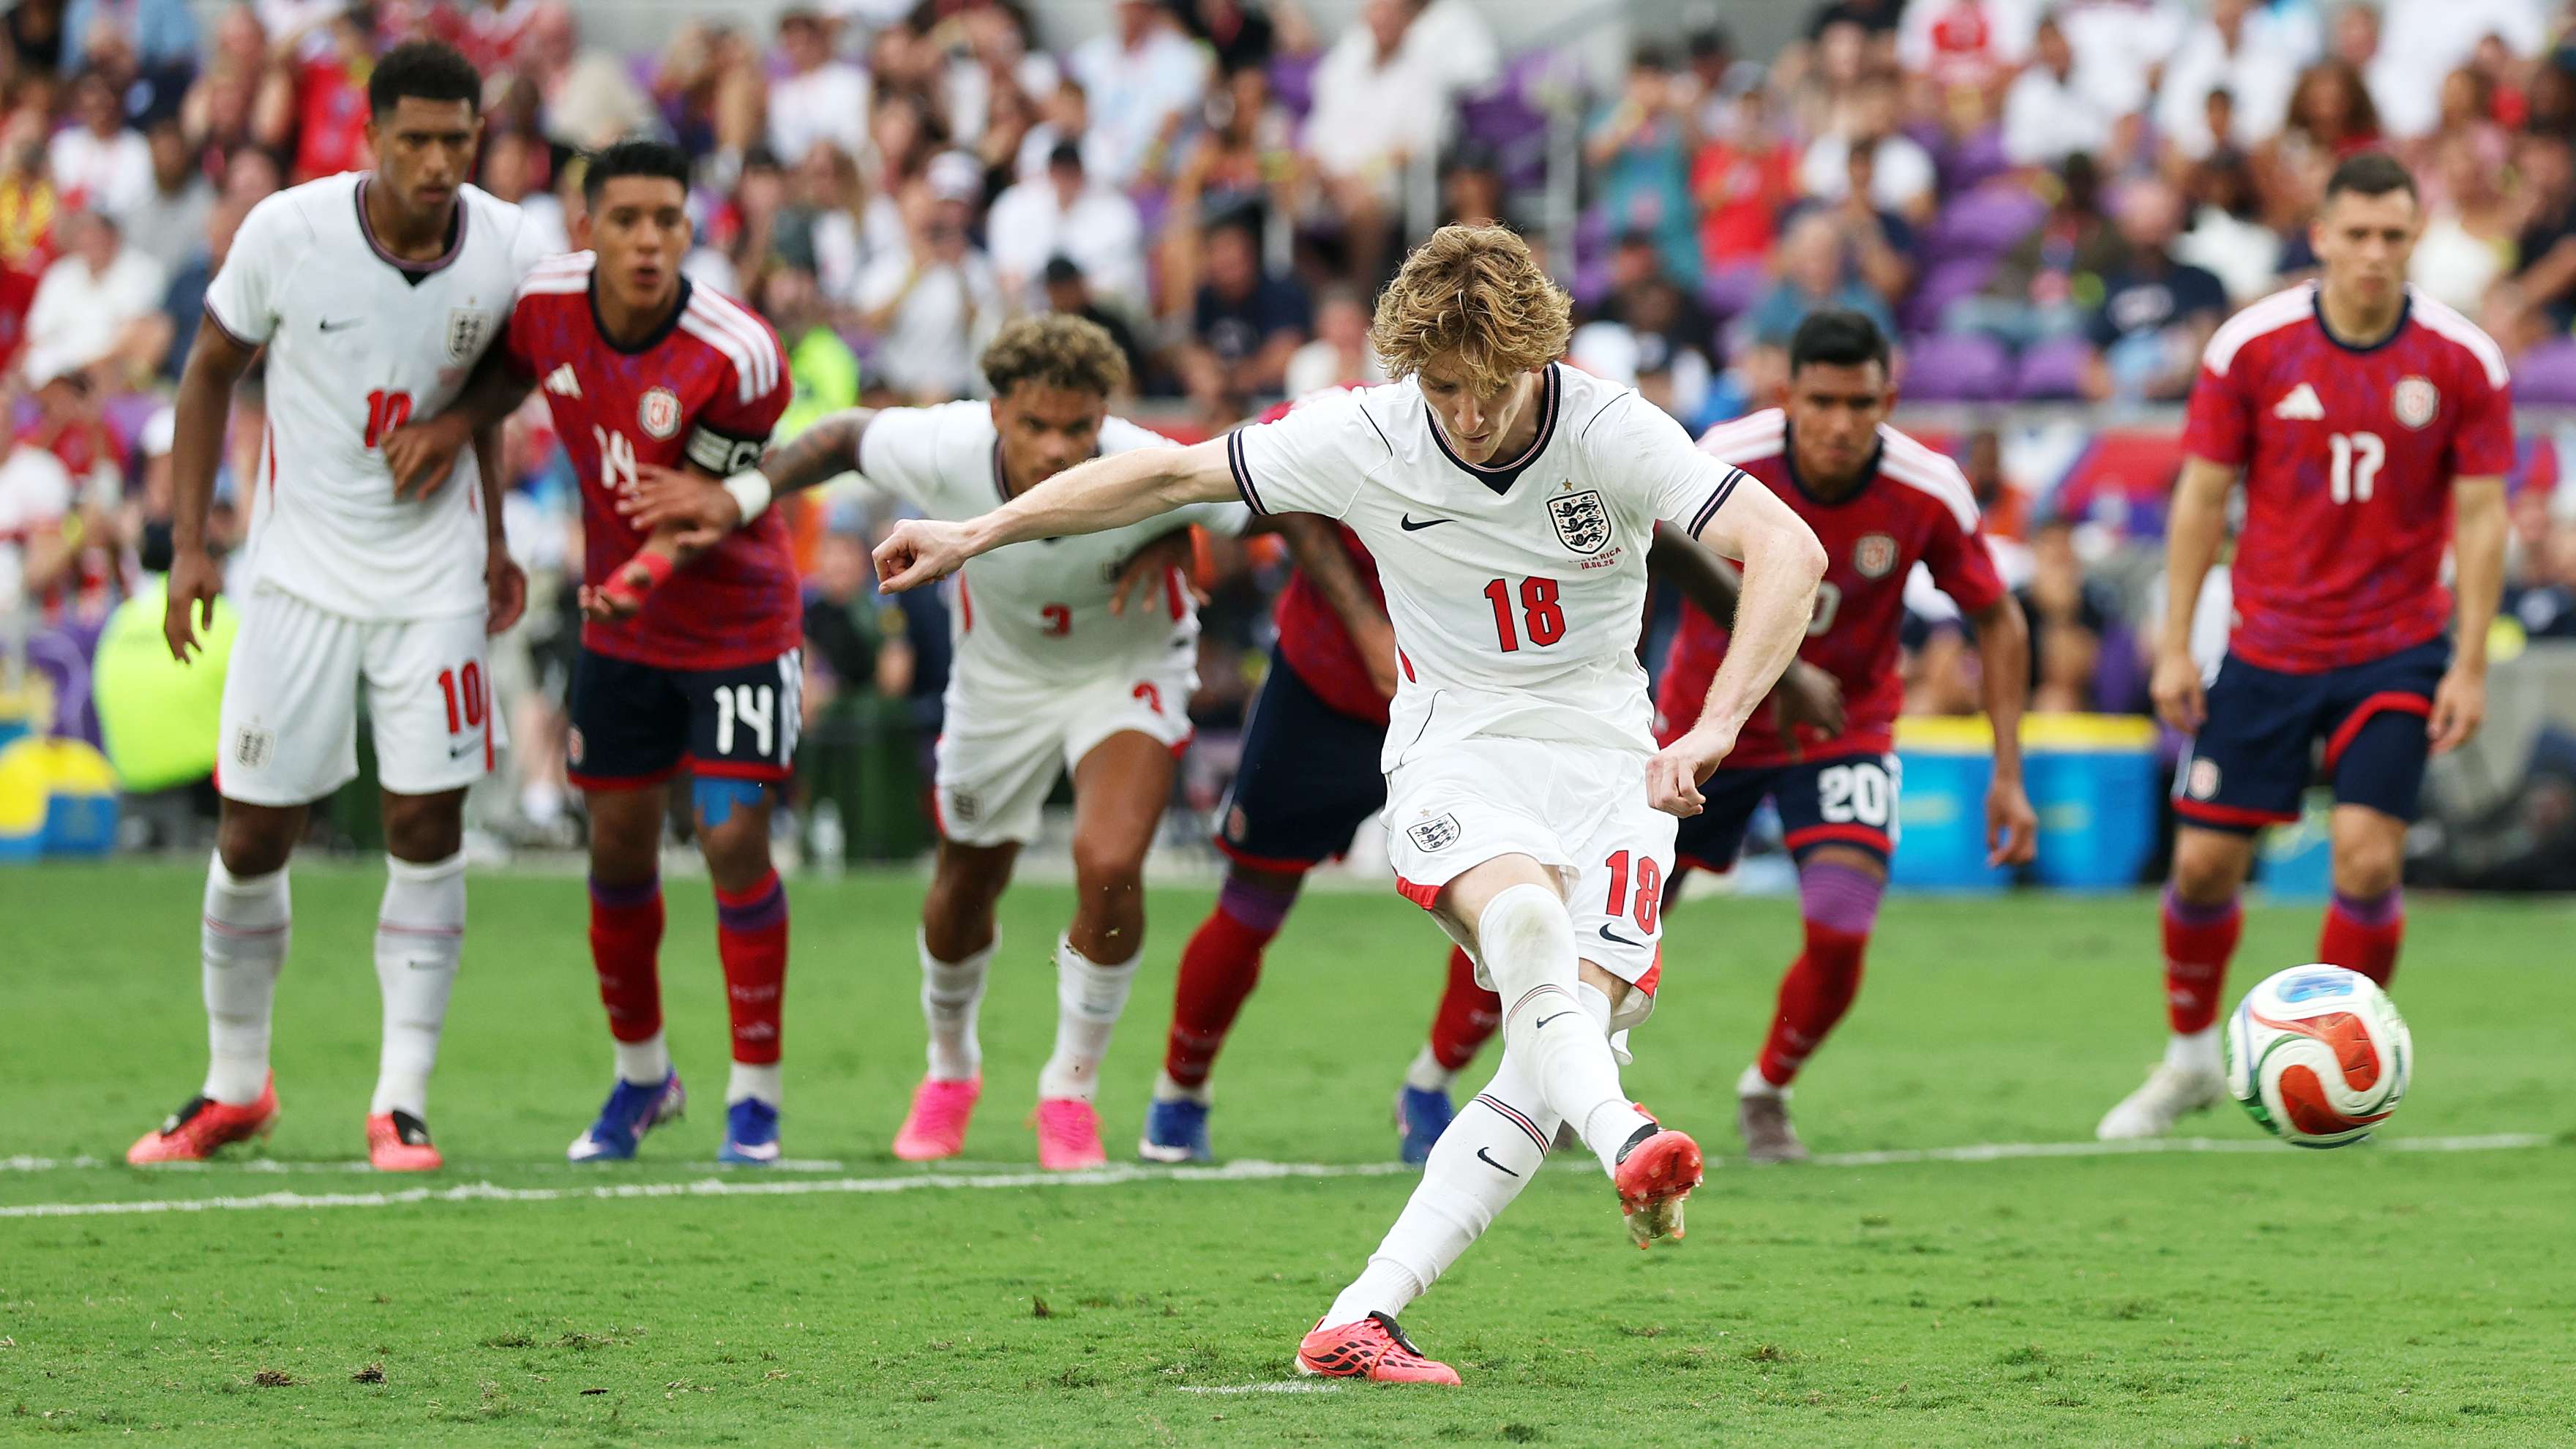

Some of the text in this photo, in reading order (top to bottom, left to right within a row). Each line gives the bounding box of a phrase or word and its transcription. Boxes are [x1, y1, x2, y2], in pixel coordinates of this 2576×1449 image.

[365, 389, 413, 448] 10
[591, 423, 638, 490] 14
[2328, 431, 2386, 505] 17
[1599, 547, 1621, 559] RICA
[1041, 602, 1071, 638] 3
[1483, 575, 1567, 653] 18
[438, 660, 482, 735] 10
[714, 683, 774, 757] 14
[1816, 762, 1889, 827] 20
[1605, 849, 1662, 936] 18
